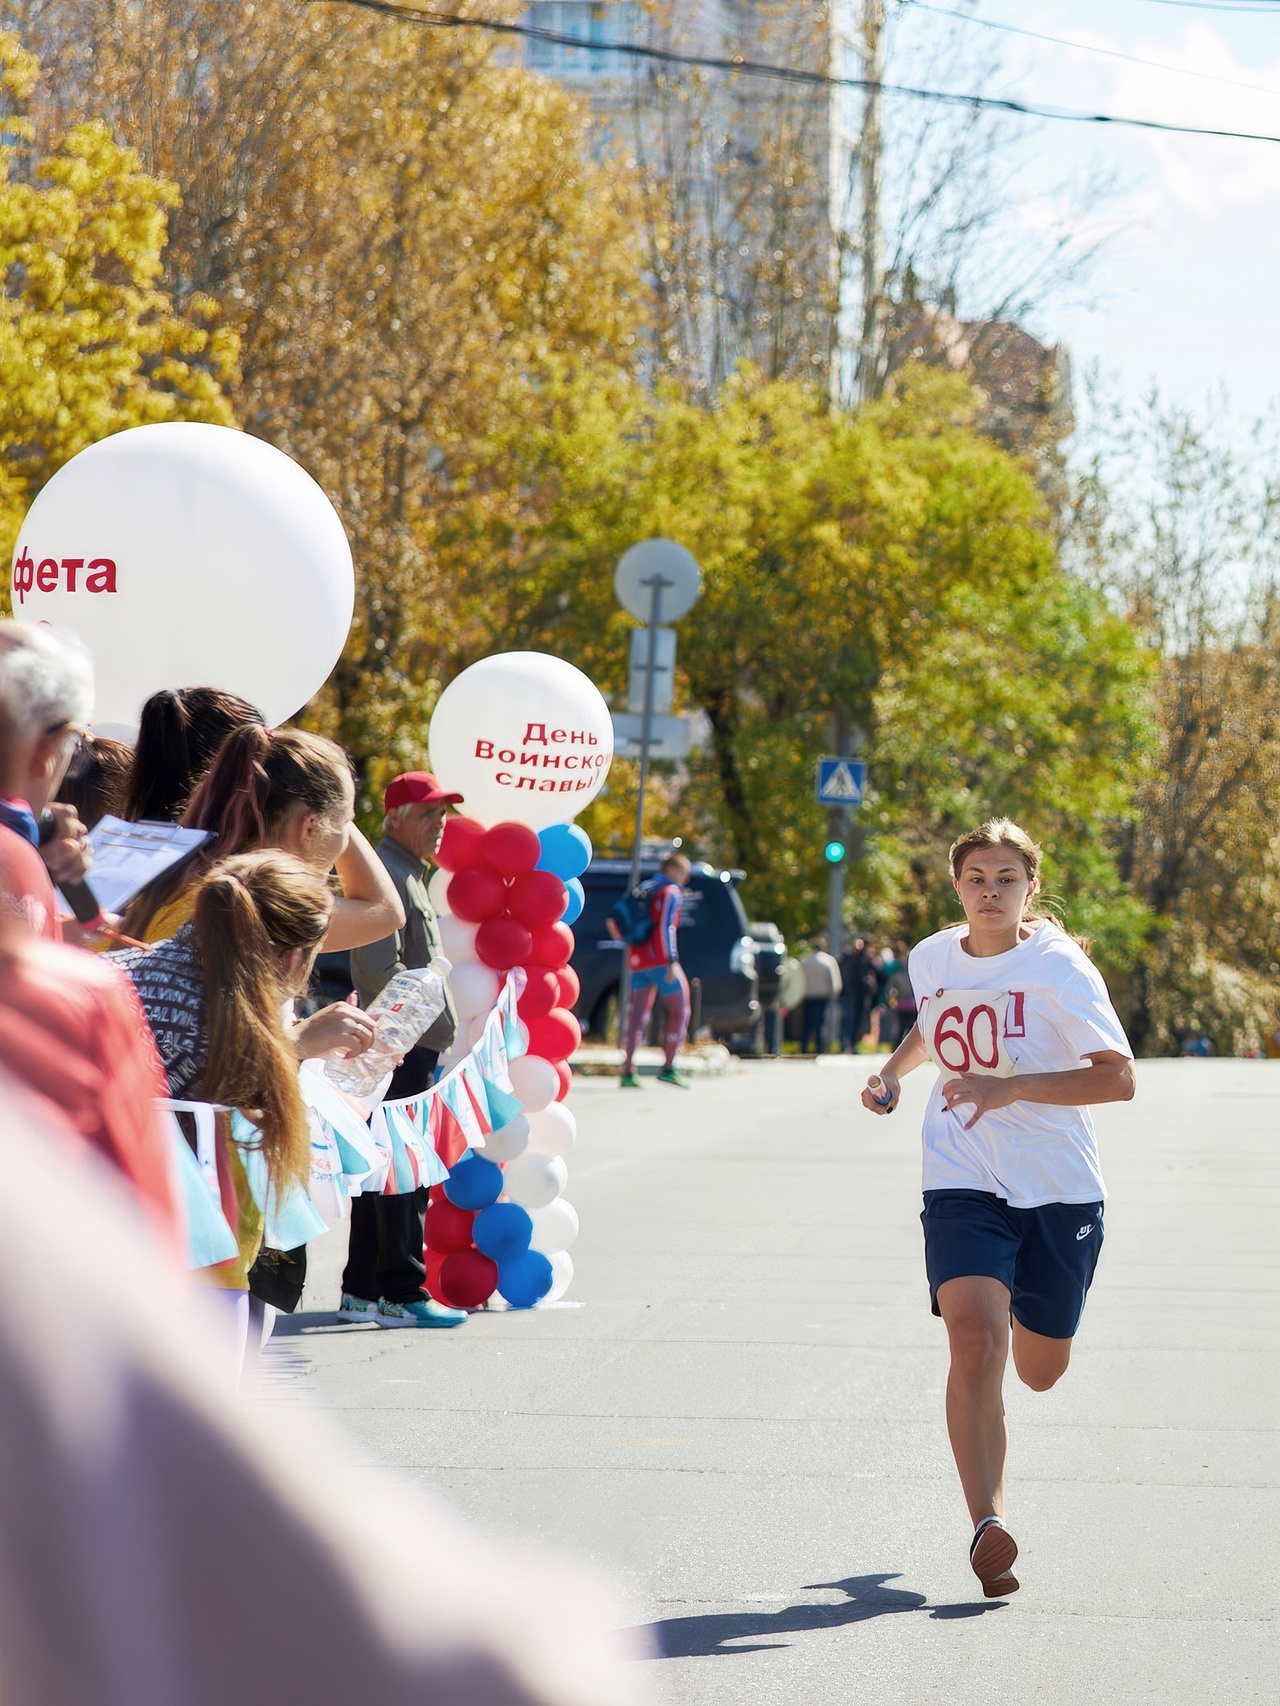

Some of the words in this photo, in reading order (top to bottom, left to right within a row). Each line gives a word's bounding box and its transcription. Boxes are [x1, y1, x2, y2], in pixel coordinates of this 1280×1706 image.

[13, 545, 117, 605] фета
[522, 723, 598, 746] День
[934, 1004, 999, 1073] 60
